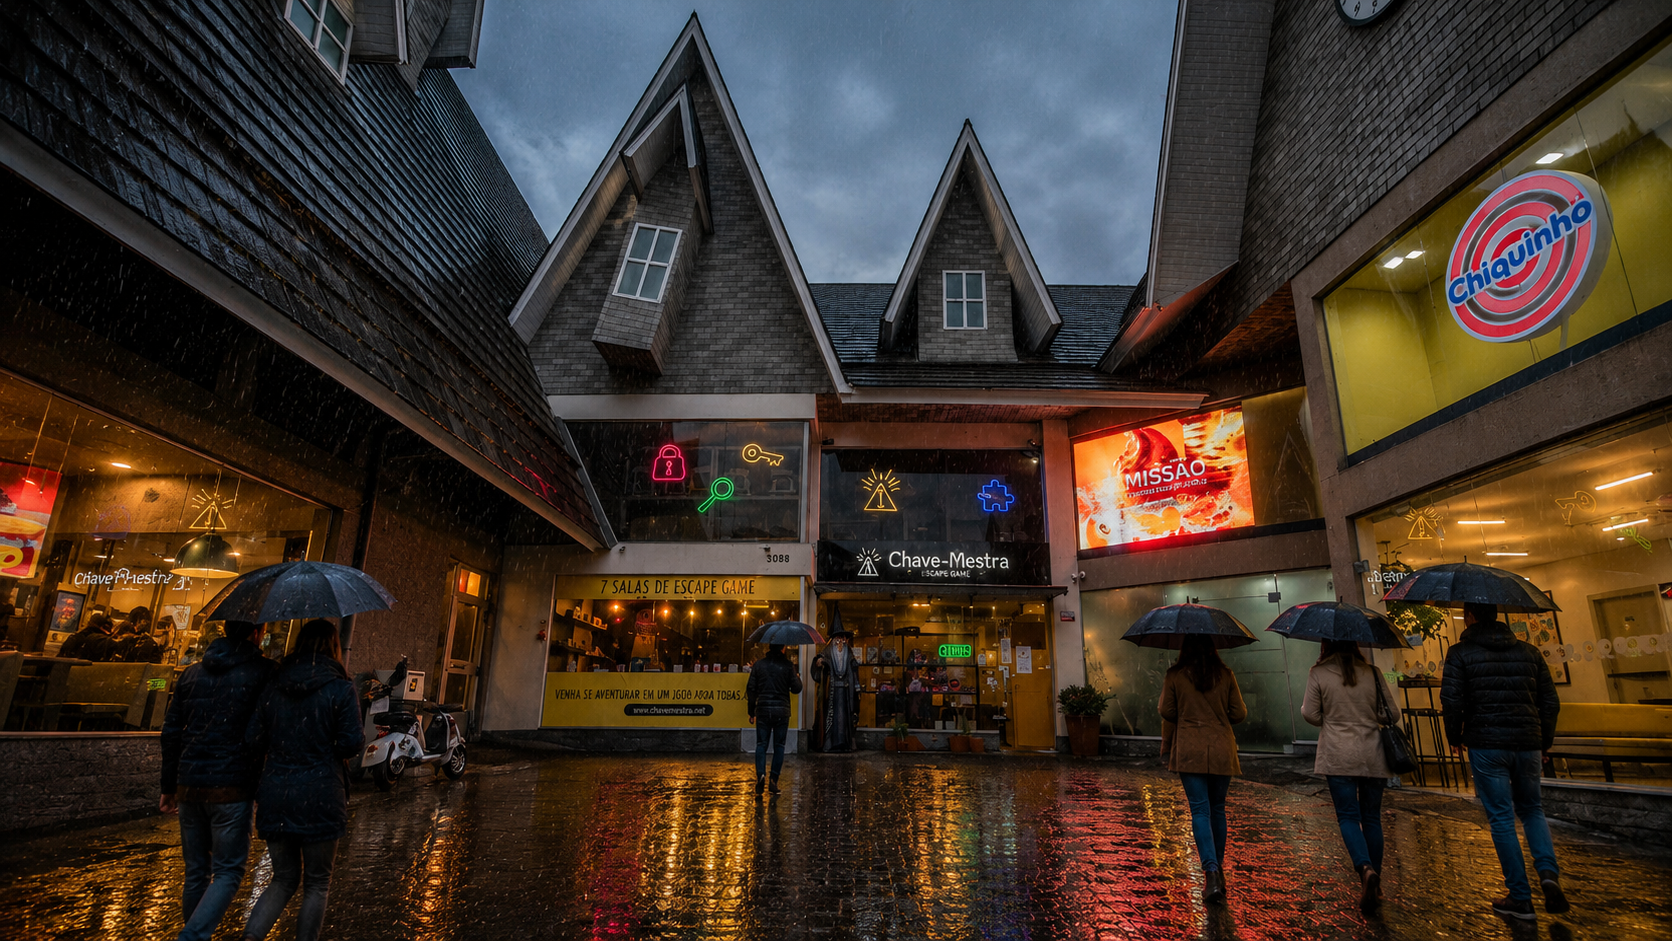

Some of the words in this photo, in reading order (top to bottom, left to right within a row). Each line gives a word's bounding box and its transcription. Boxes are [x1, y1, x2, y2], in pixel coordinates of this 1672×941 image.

[766, 554, 790, 563] 3088
[888, 550, 1009, 569] Chave-Mestra
[600, 580, 608, 594] 7
[612, 580, 649, 594] SALAS
[654, 580, 669, 594] DE
[674, 580, 717, 594] ESCAPE
[721, 580, 755, 594] GAME
[583, 689, 593, 700] SE
[595, 689, 640, 700] AVENTURAR
[657, 689, 669, 700] UM
